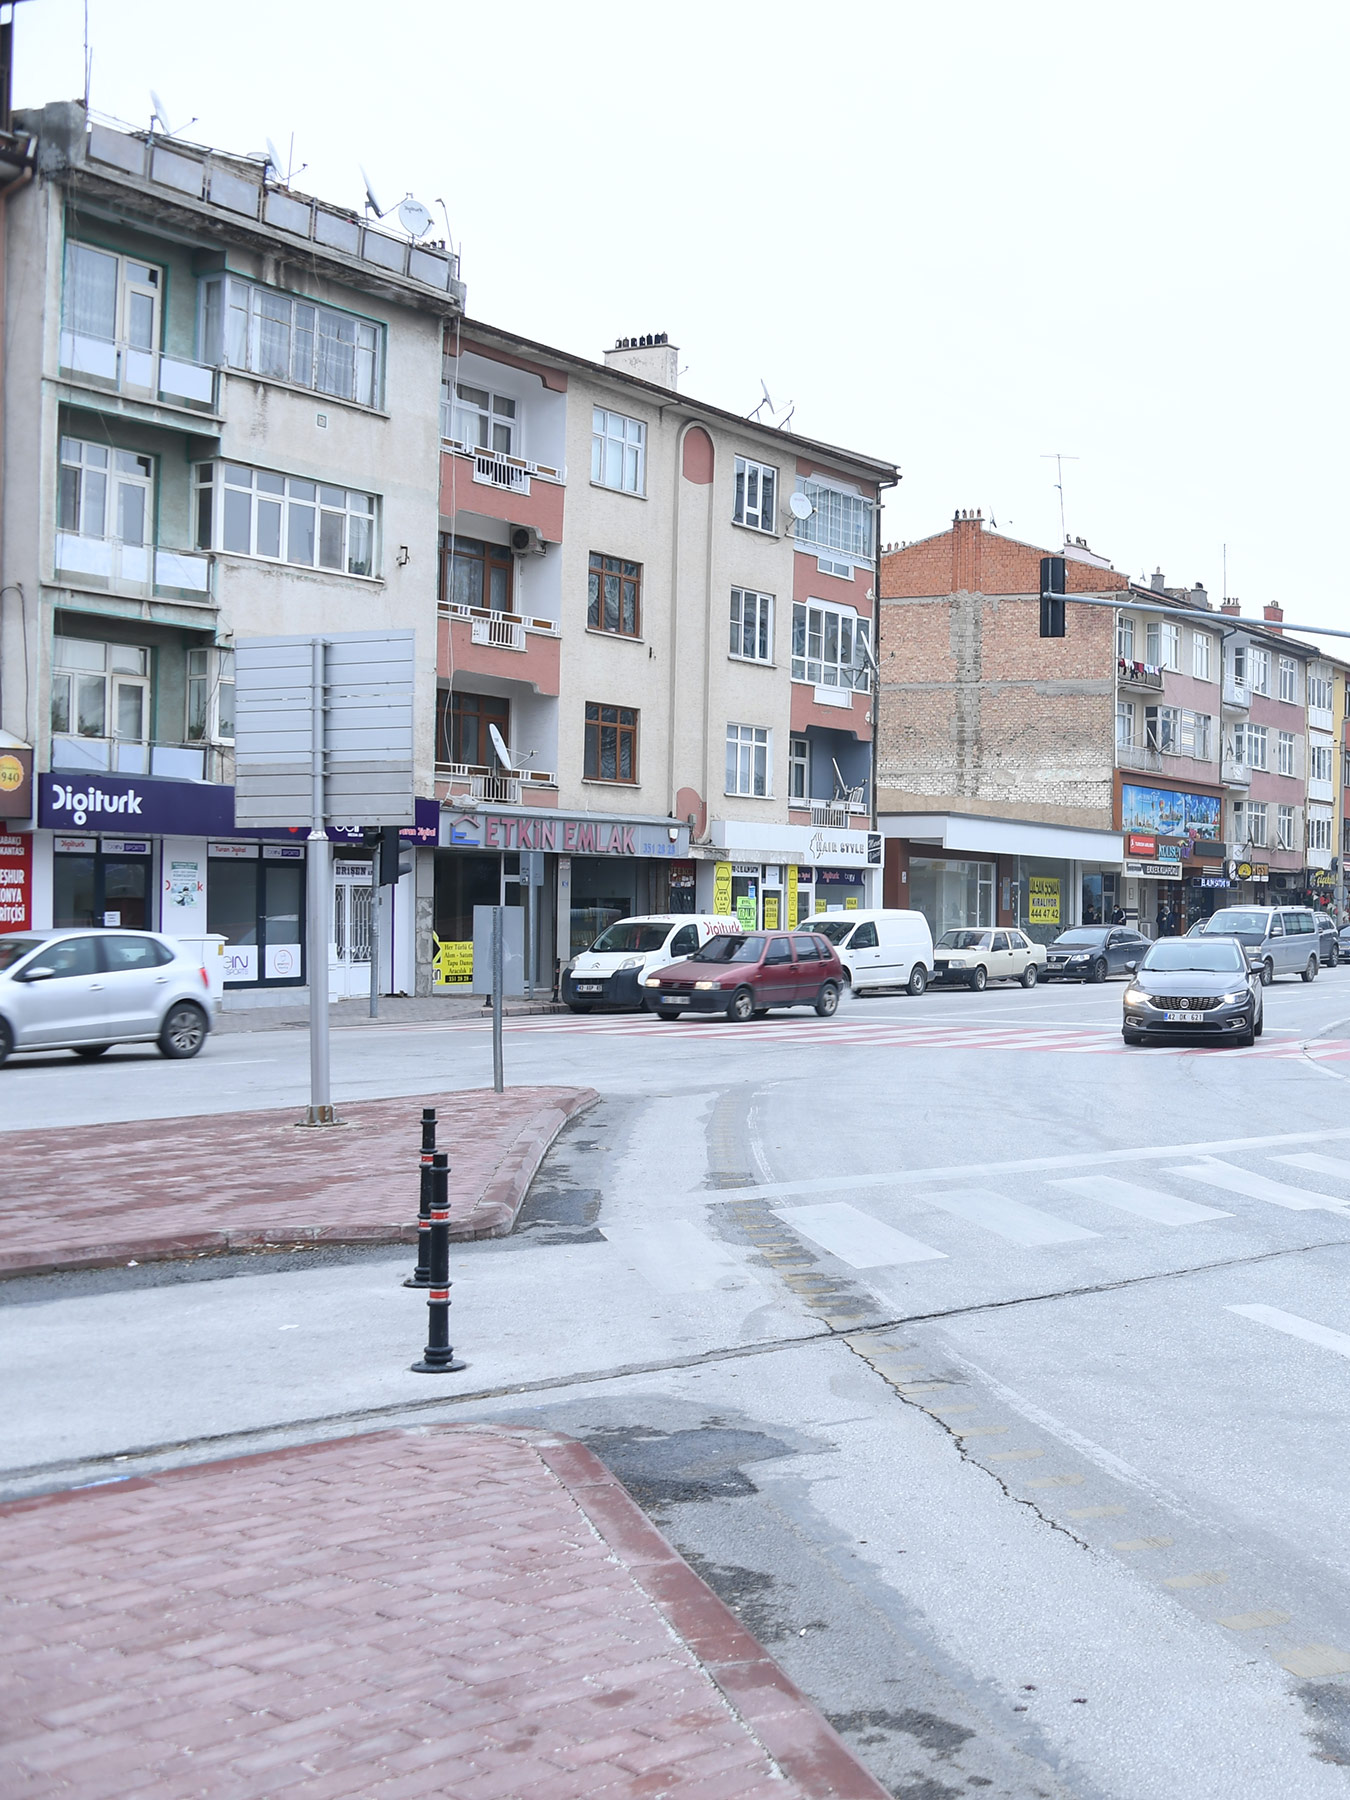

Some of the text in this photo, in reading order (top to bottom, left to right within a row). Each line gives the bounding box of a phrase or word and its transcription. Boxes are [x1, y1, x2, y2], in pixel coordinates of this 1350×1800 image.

[52, 784, 143, 826] Digiturk
[563, 822, 636, 854] EMLAK
[816, 841, 837, 853] HAIR
[840, 843, 864, 854] STYLE
[1031, 909, 1059, 919] 444 47 42
